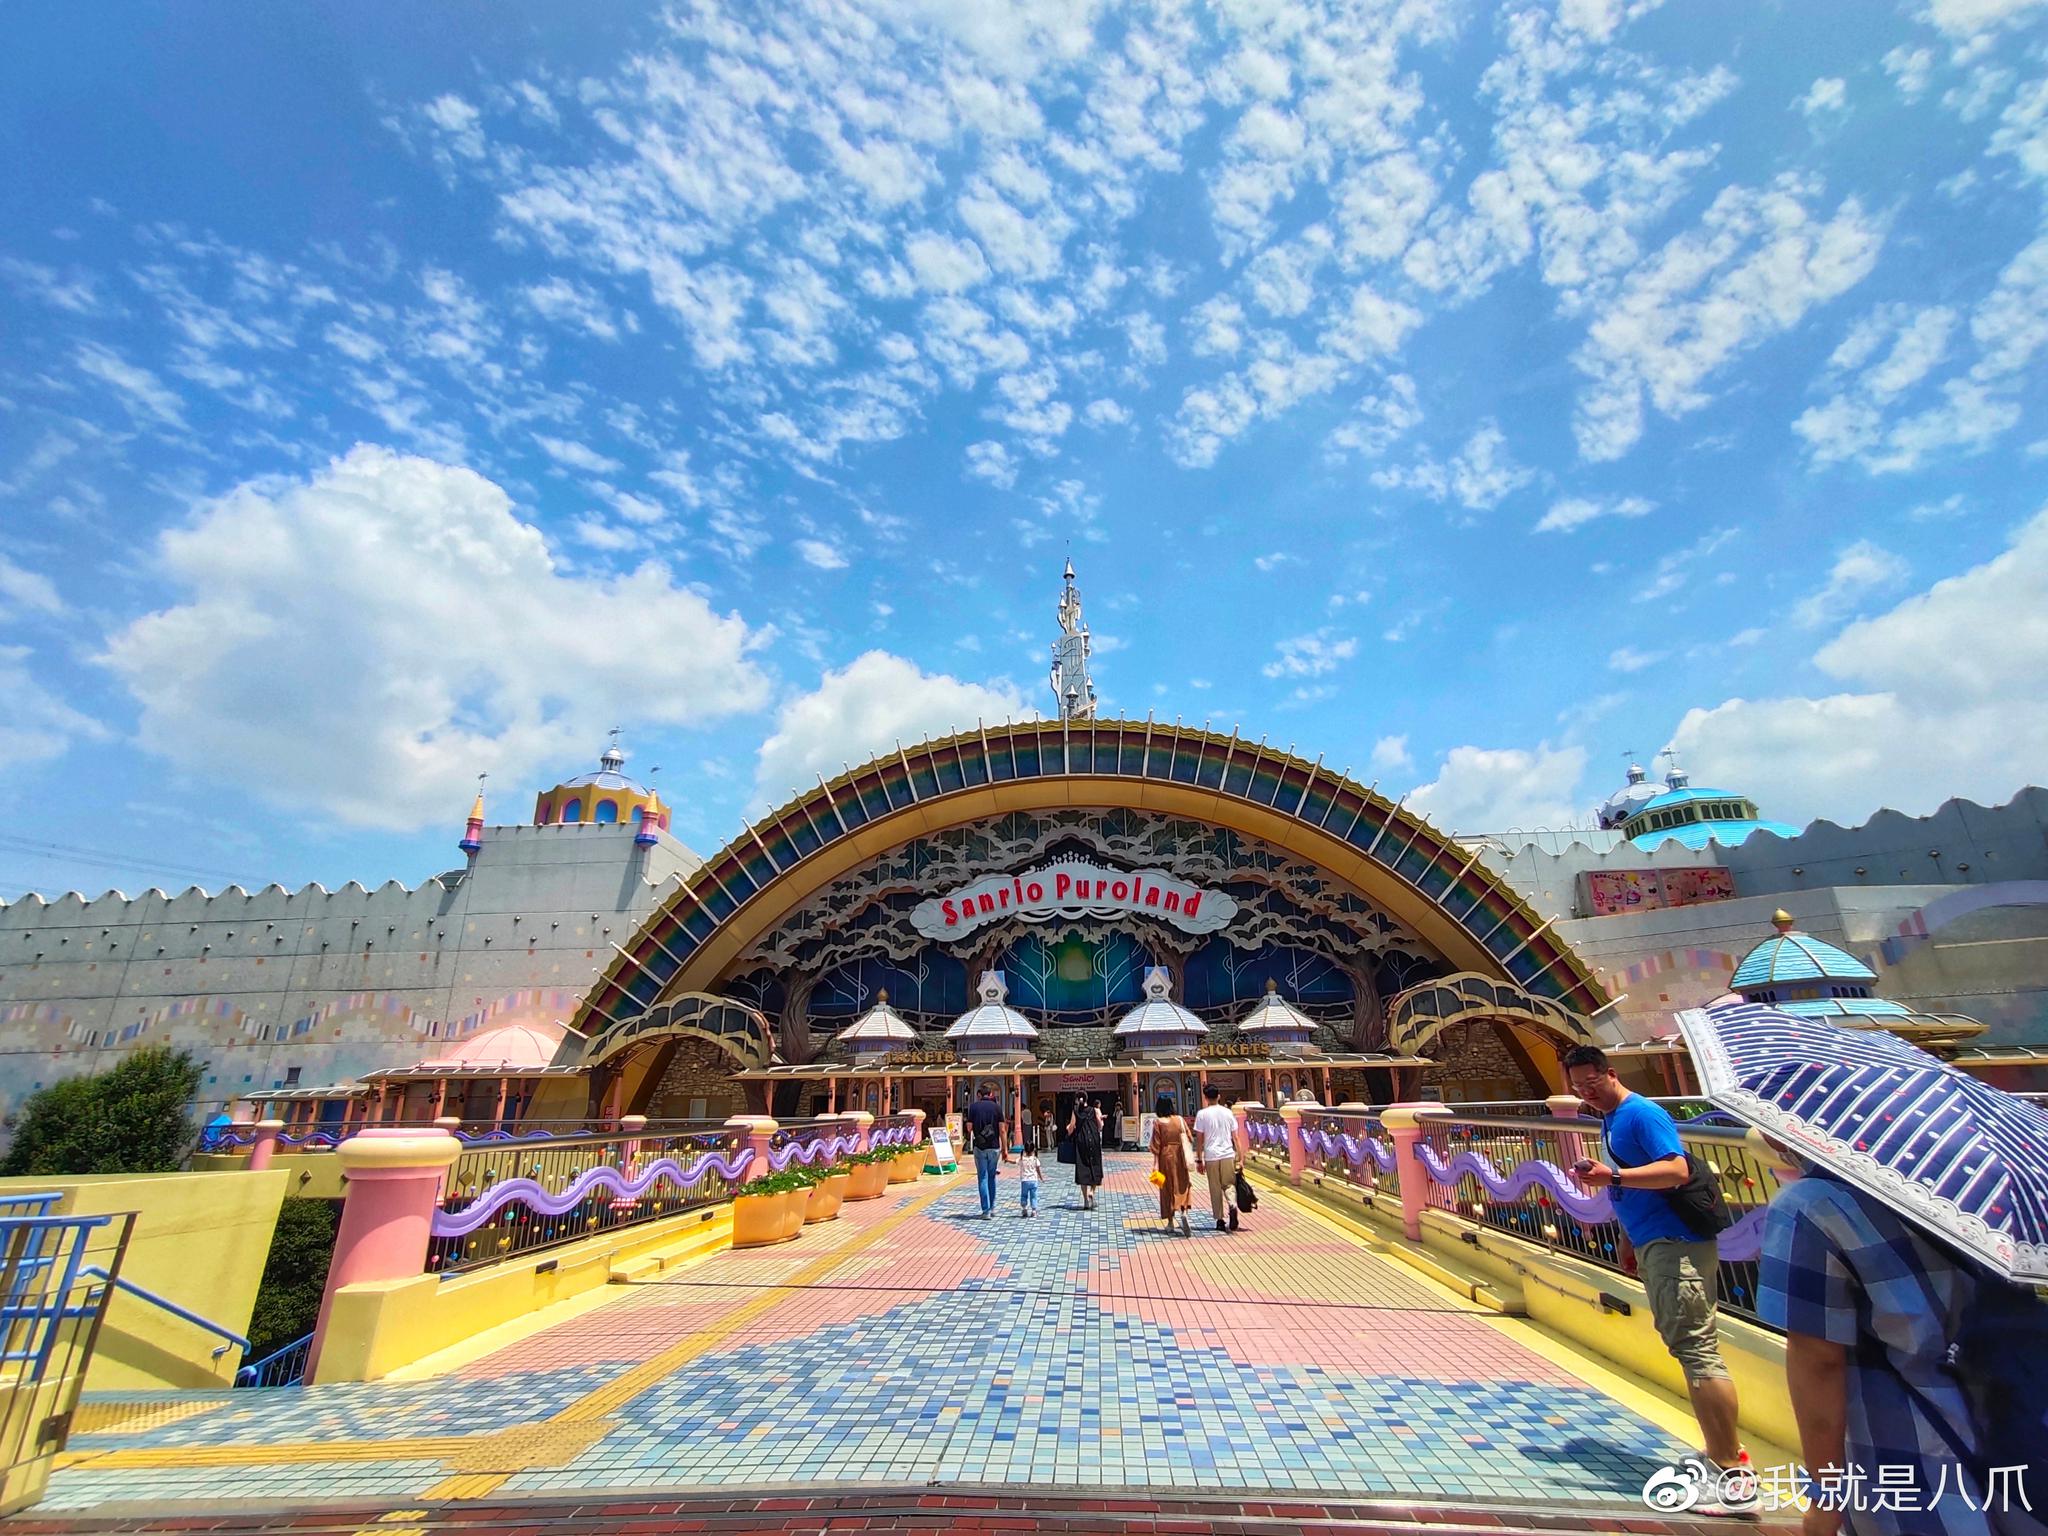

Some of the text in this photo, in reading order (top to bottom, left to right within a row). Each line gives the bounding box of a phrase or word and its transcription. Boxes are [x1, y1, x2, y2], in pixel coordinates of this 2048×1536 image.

[940, 873, 1203, 926] Sanrio Puroland
[1200, 1042, 1270, 1056] TICKETS
